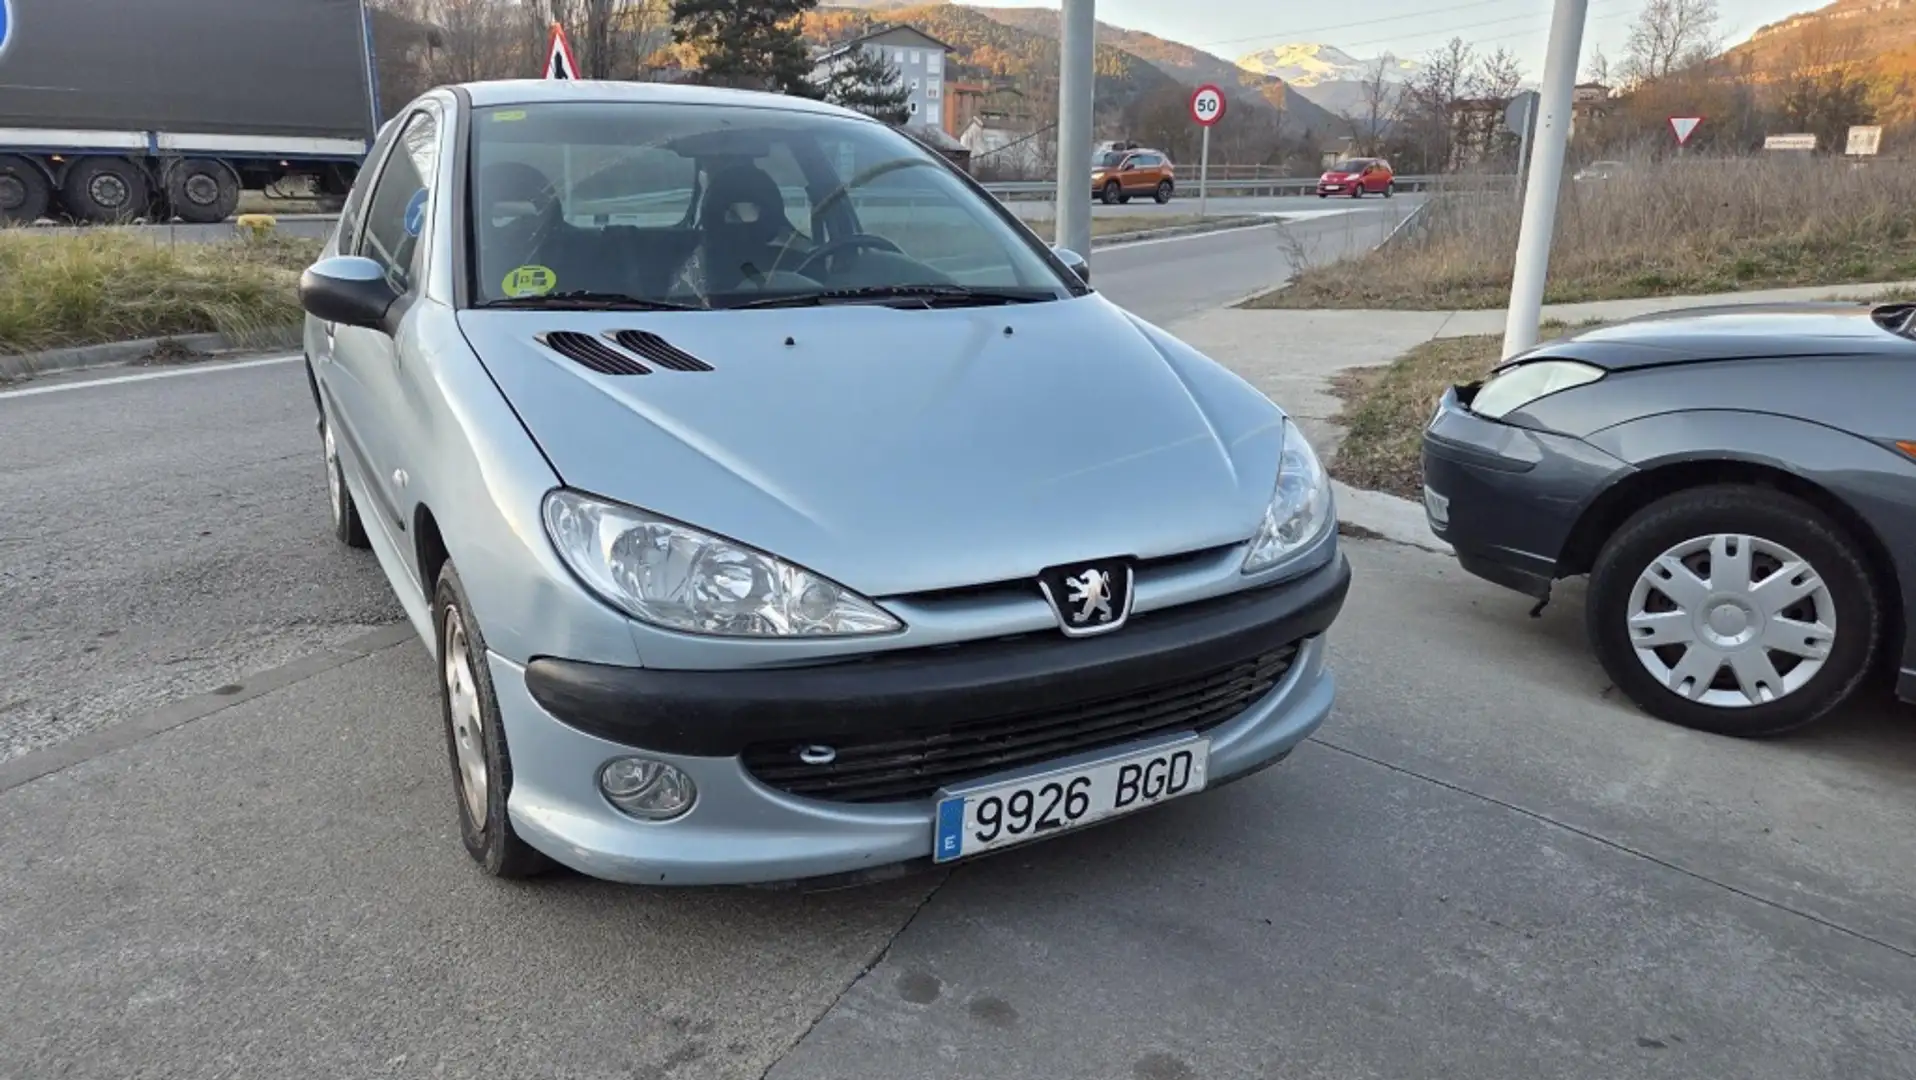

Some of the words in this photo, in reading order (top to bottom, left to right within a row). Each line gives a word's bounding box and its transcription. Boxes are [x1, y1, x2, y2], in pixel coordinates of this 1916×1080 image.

[1197, 98, 1217, 112] 50
[975, 776, 1092, 842] 9926
[1114, 750, 1193, 809] BGD
[944, 835, 956, 851] E
